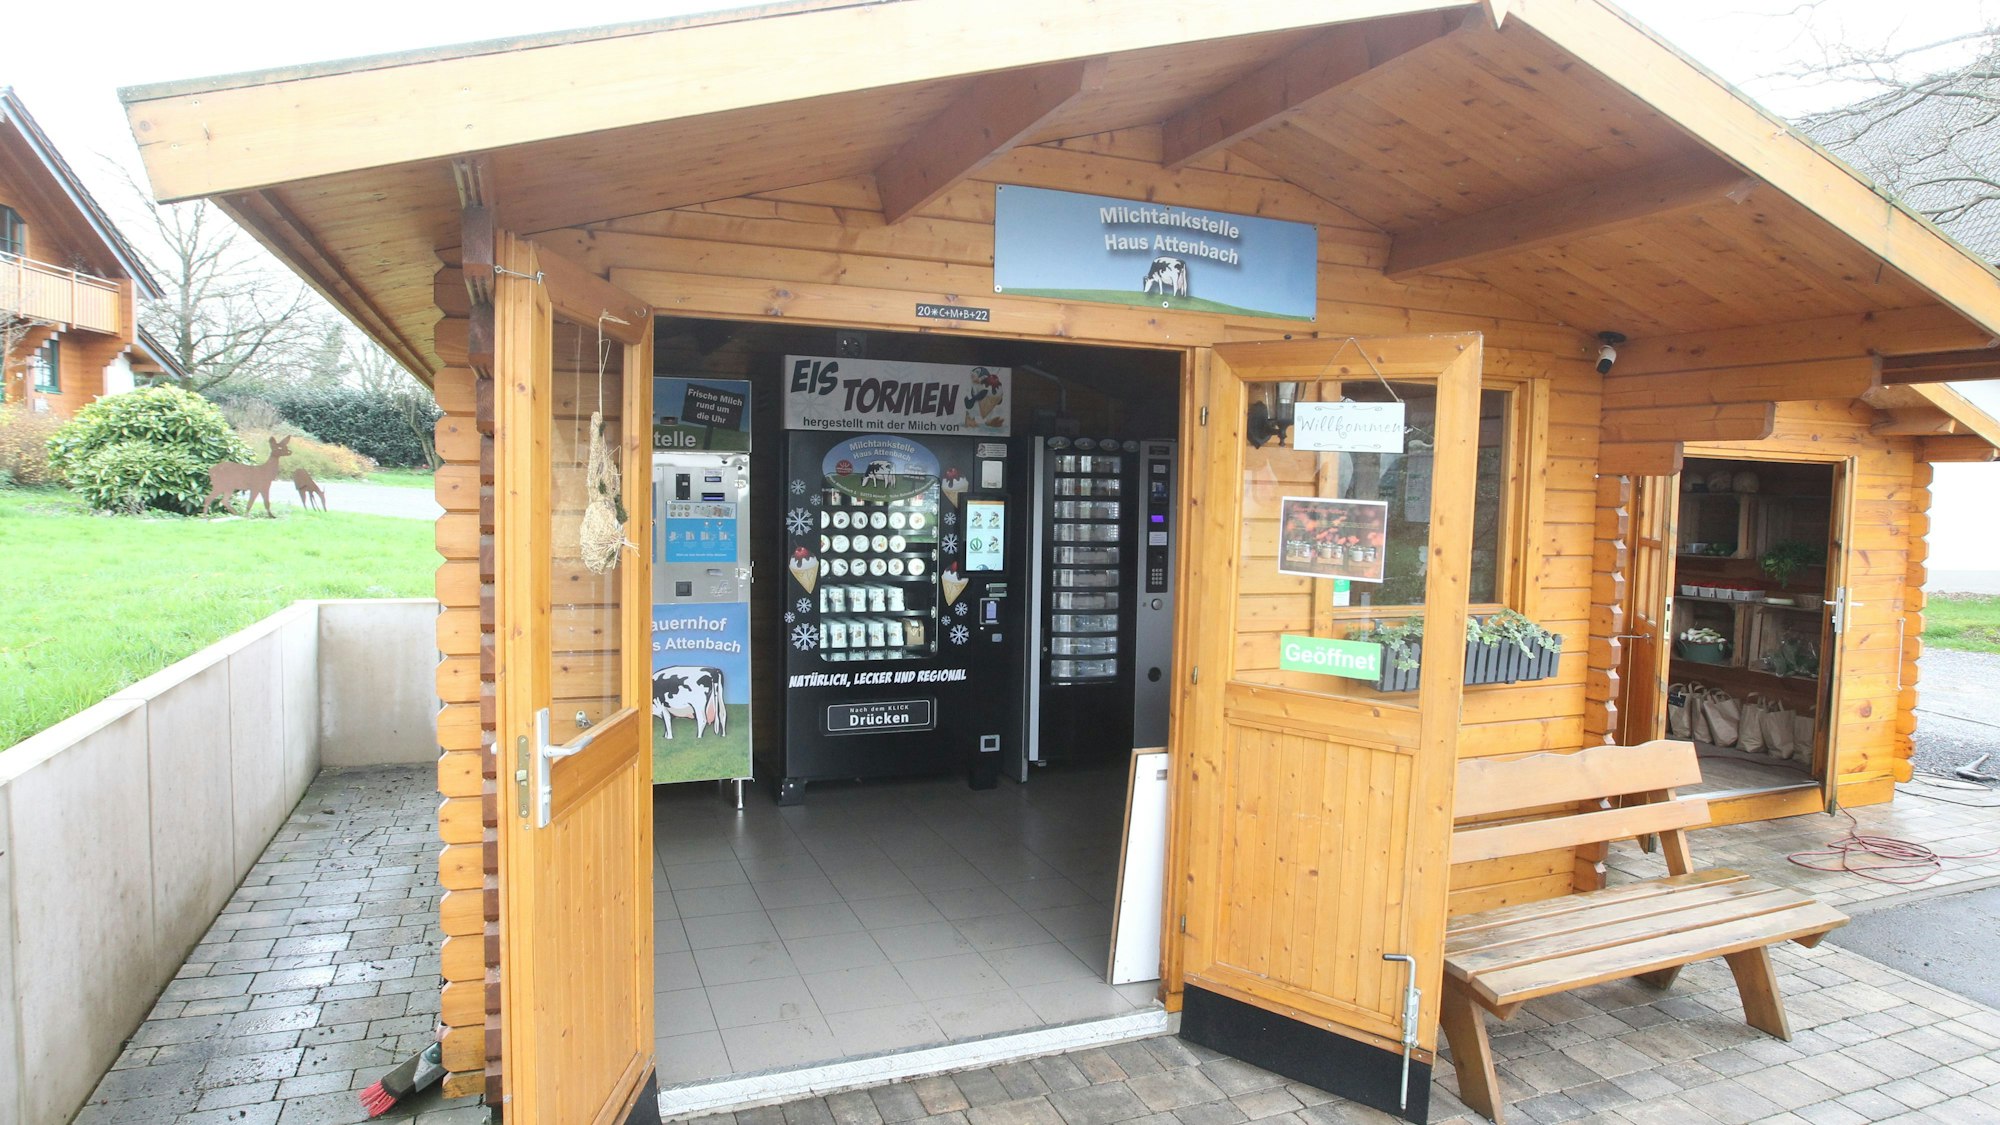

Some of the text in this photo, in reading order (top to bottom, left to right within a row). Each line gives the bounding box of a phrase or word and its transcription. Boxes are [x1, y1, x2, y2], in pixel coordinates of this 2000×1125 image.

[1099, 206, 1240, 239] Milchtankstelle
[1104, 234, 1239, 265] Haus Attenbach
[790, 359, 840, 396] EIS
[687, 388, 743, 407] Frische Milch
[843, 377, 960, 418] TORMEN
[696, 400, 730, 414] rund um
[696, 412, 727, 424] die Uhr
[803, 416, 960, 432] hergestellt mit der Milch von
[1297, 415, 1405, 440] Willkommen
[653, 430, 697, 448] telle
[849, 439, 916, 454] Milchtankstelle
[853, 448, 911, 462] Haus Attenbach
[652, 615, 728, 632] auernhof
[652, 636, 741, 653] s Attenbach
[1284, 642, 1377, 672] Geöffnet
[788, 668, 967, 689] NATÜRLICH, LECKER UND REGIONAL
[849, 712, 909, 727] Drücken
